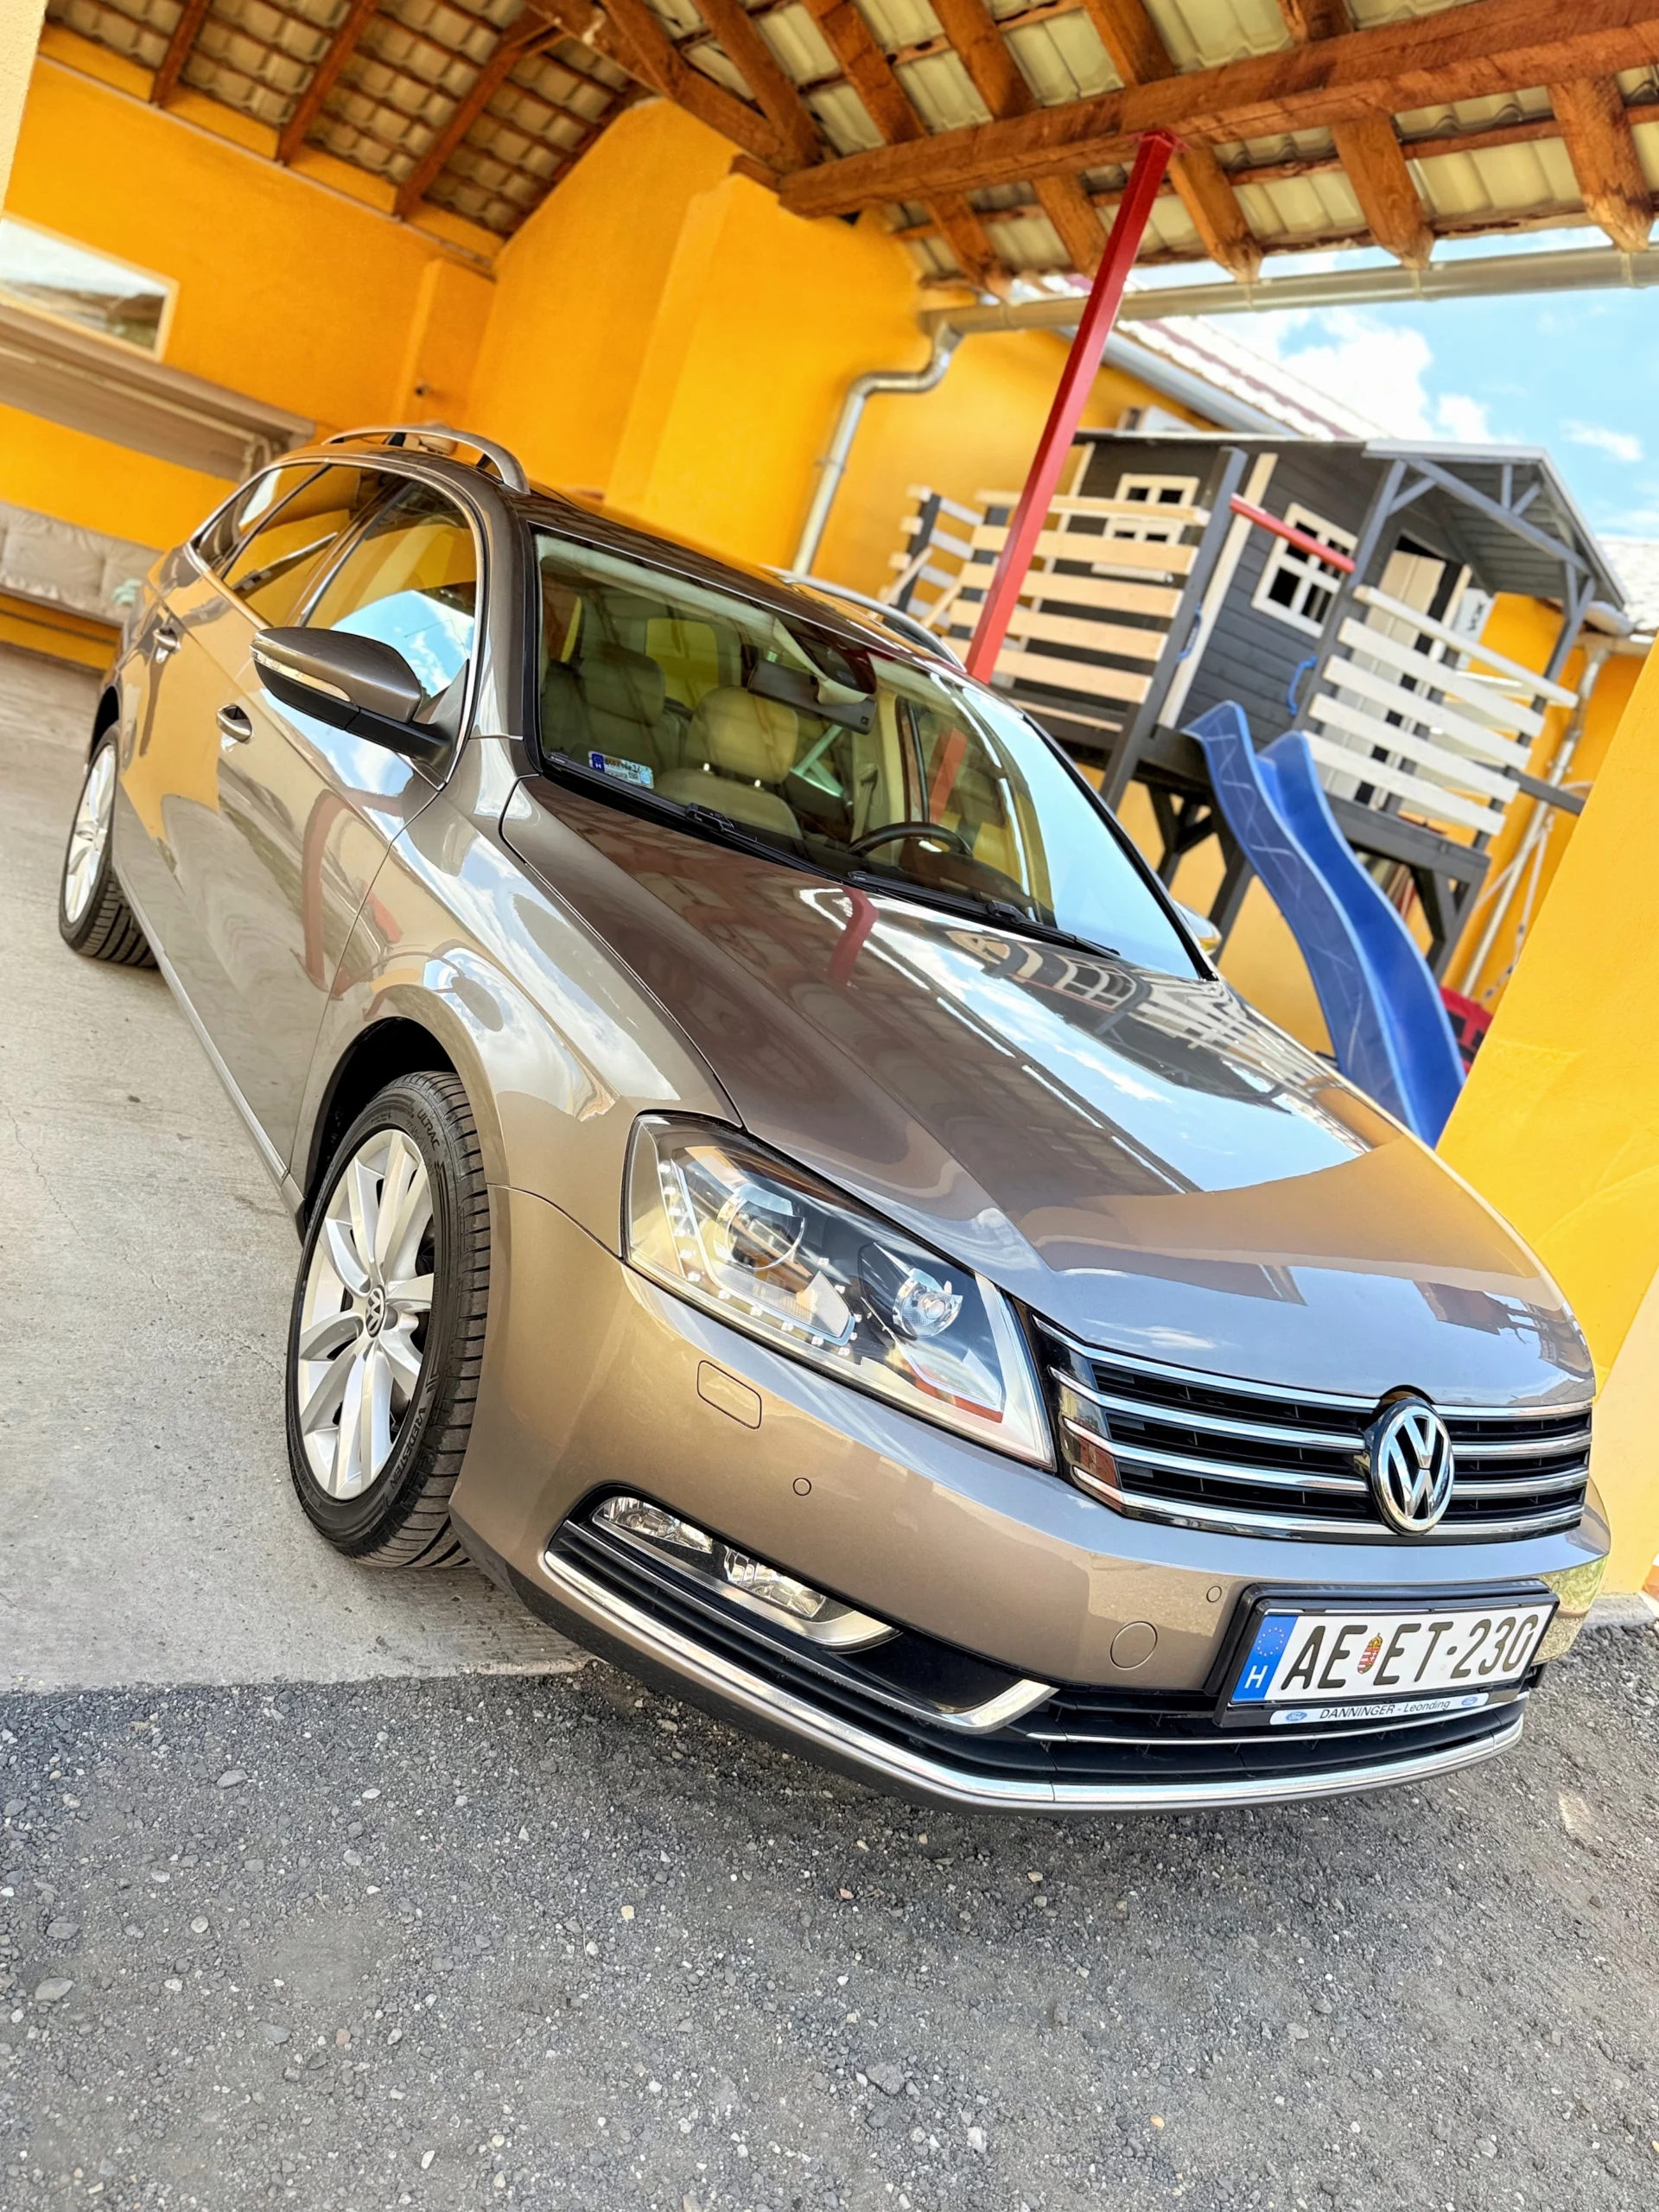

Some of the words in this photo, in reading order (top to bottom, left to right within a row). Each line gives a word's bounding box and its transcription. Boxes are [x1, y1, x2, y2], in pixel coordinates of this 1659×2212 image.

[416, 1109, 441, 1151] ULTRAC
[390, 1407, 427, 1489] VREDESTEIN
[1245, 1665, 1263, 1689] H
[1281, 1624, 1368, 1690] AE
[1319, 1703, 1396, 1719] DANNINGER
[1403, 1700, 1452, 1713] Leonding
